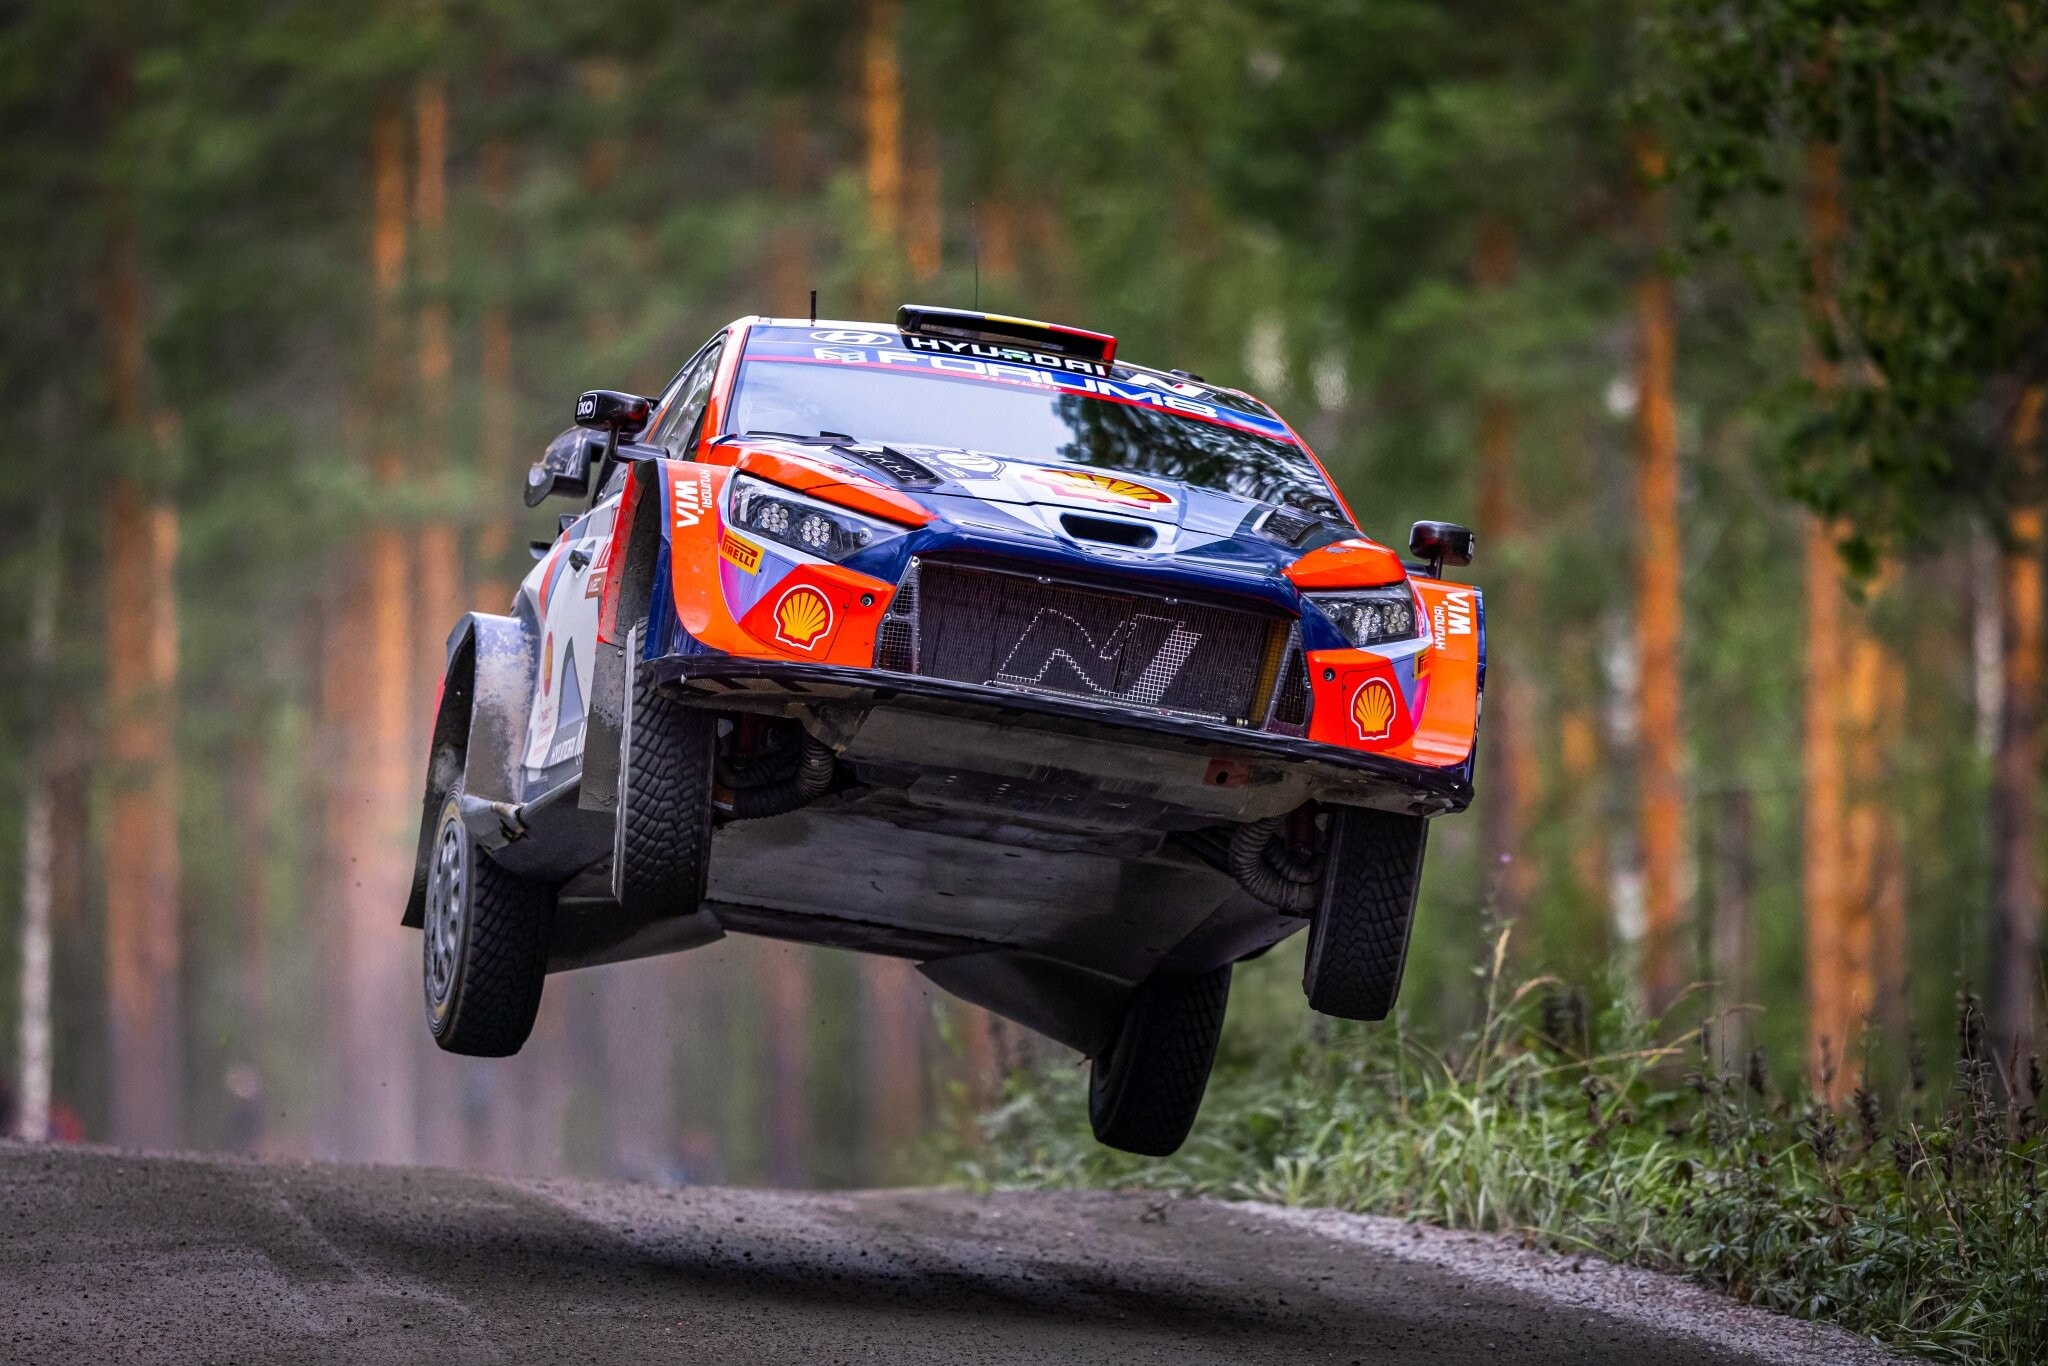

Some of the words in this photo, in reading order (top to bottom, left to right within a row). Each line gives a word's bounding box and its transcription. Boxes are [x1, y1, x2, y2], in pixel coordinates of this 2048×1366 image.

[910, 337, 1107, 377] HYUNDAI
[877, 351, 1218, 418] FORUM8
[699, 469, 713, 509] HYUNDAI
[721, 534, 758, 568] PIRELLI
[1433, 606, 1446, 650] HYUNDAI
